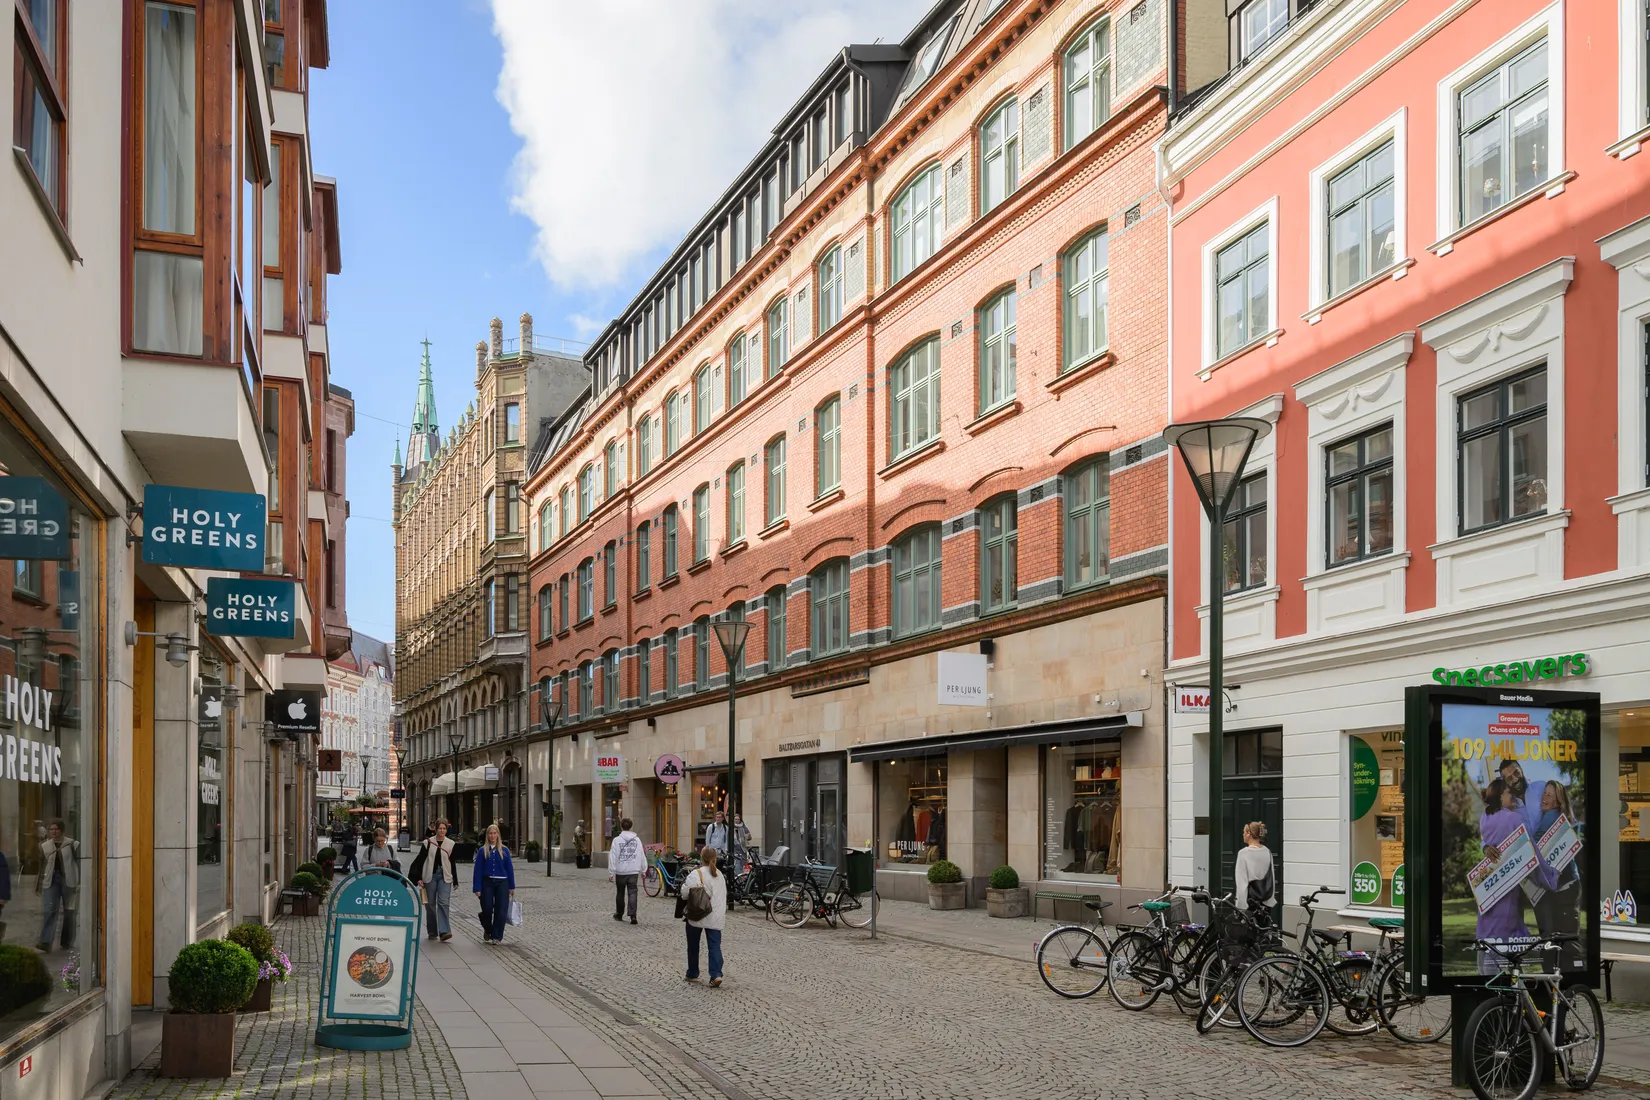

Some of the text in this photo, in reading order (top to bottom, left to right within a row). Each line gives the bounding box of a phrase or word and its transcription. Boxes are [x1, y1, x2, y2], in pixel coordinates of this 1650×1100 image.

[172, 508, 242, 528] HOLY
[151, 526, 258, 550] GREENS
[228, 594, 278, 608] HOLY
[212, 608, 290, 623] GREENS
[1432, 653, 1586, 687] Specsavers
[946, 684, 982, 694] PER LJUNG
[5, 674, 52, 731] HOLY
[1531, 728, 1538, 736] på
[1452, 738, 1577, 762] 109 MILJONER
[602, 758, 618, 766] BAR
[897, 840, 925, 852] PER LJUNG
[1559, 842, 1567, 851] kr
[1484, 854, 1523, 891] 522 355 kr
[364, 889, 392, 898] HOLY
[355, 897, 398, 907] GREENS
